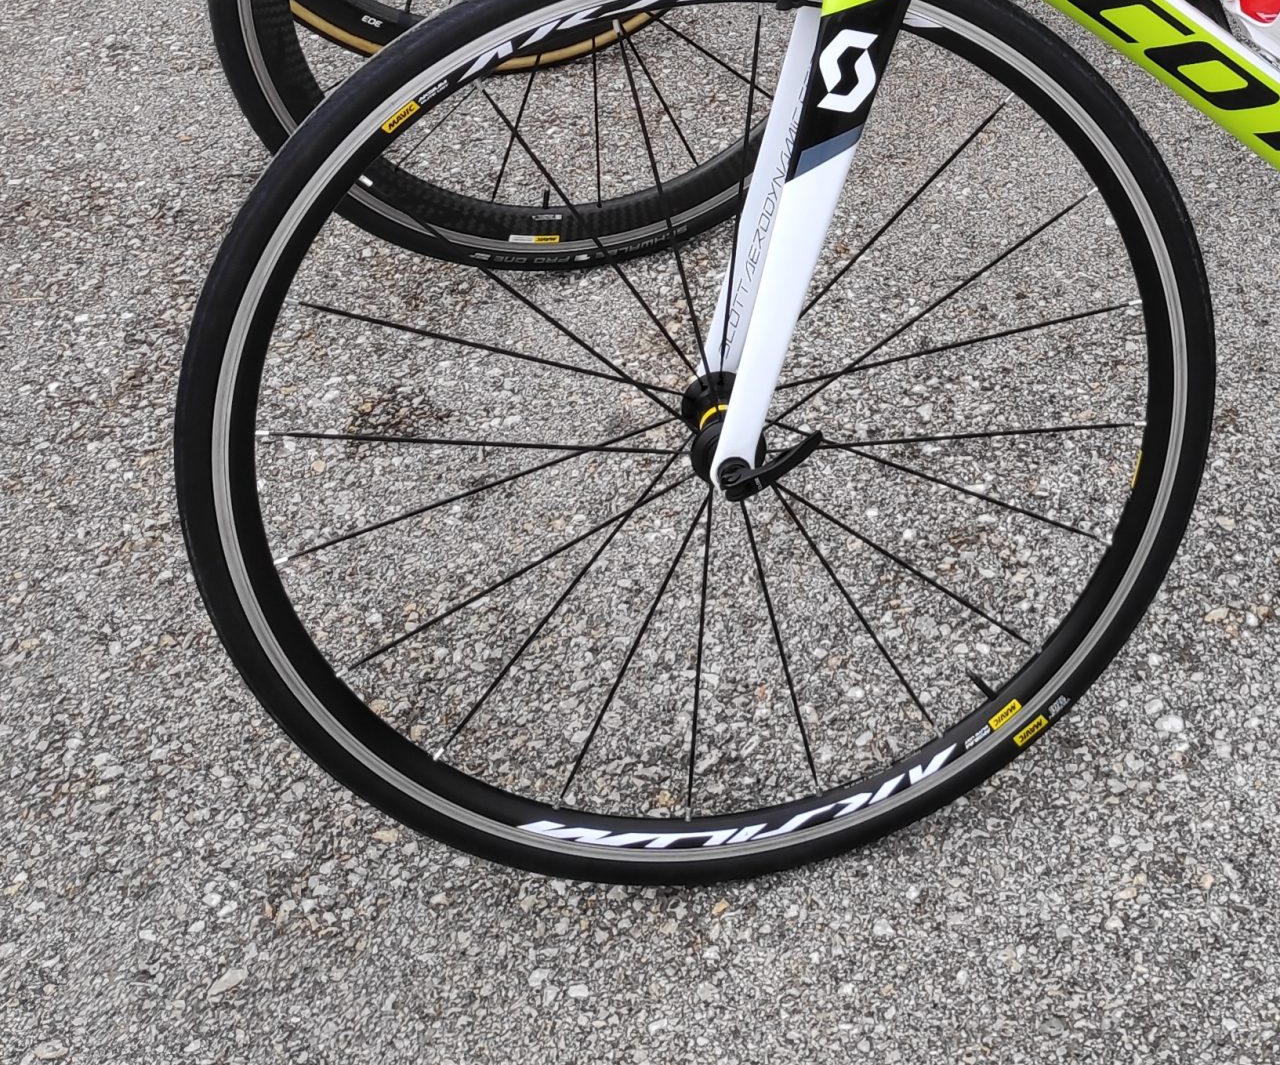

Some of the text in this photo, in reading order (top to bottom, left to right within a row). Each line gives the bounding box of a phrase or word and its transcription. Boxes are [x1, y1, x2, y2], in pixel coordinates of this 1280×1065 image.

[388, 104, 416, 131] MAVIC
[993, 702, 1017, 727] MAVIC
[1018, 718, 1044, 743] MAVIC
